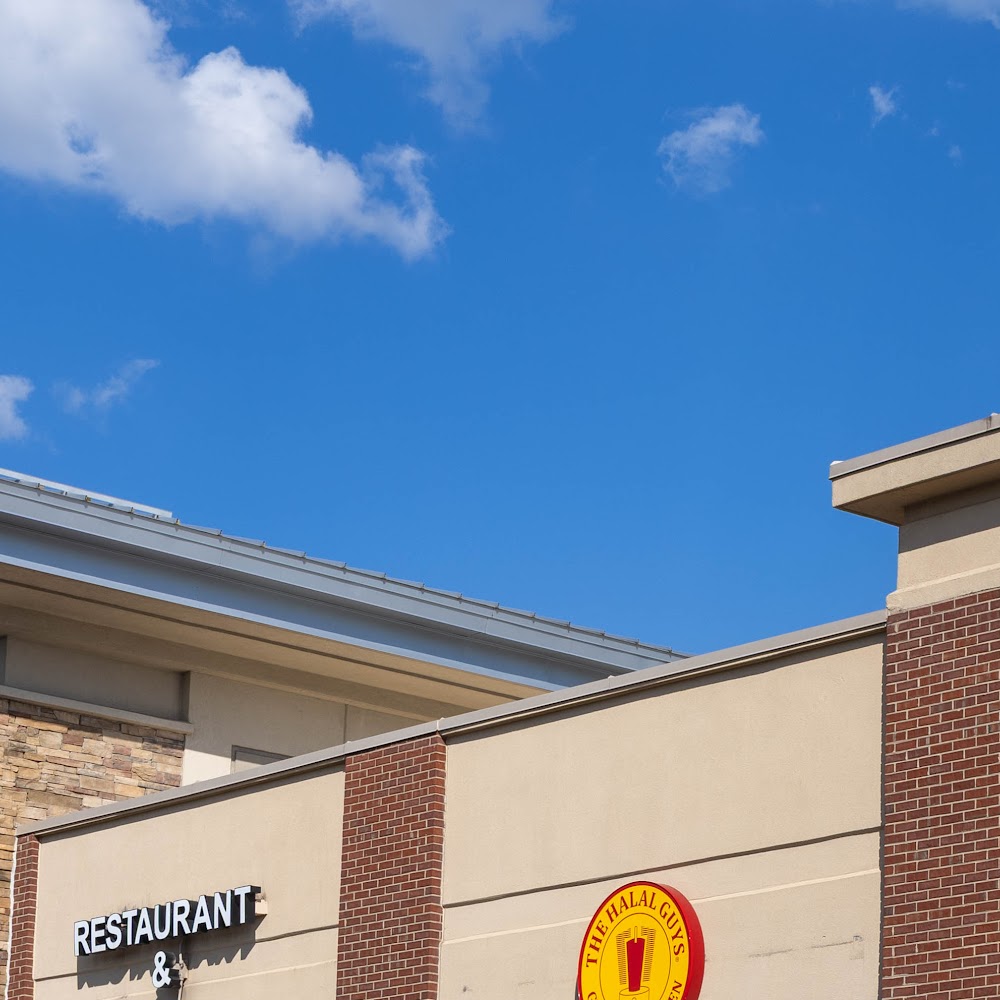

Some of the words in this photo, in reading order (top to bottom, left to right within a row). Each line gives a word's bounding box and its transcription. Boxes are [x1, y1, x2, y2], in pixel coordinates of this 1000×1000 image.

[74, 885, 258, 957] RESTAURANT
[585, 919, 608, 967] THE
[605, 890, 657, 923] HALAL
[152, 950, 173, 988] &
